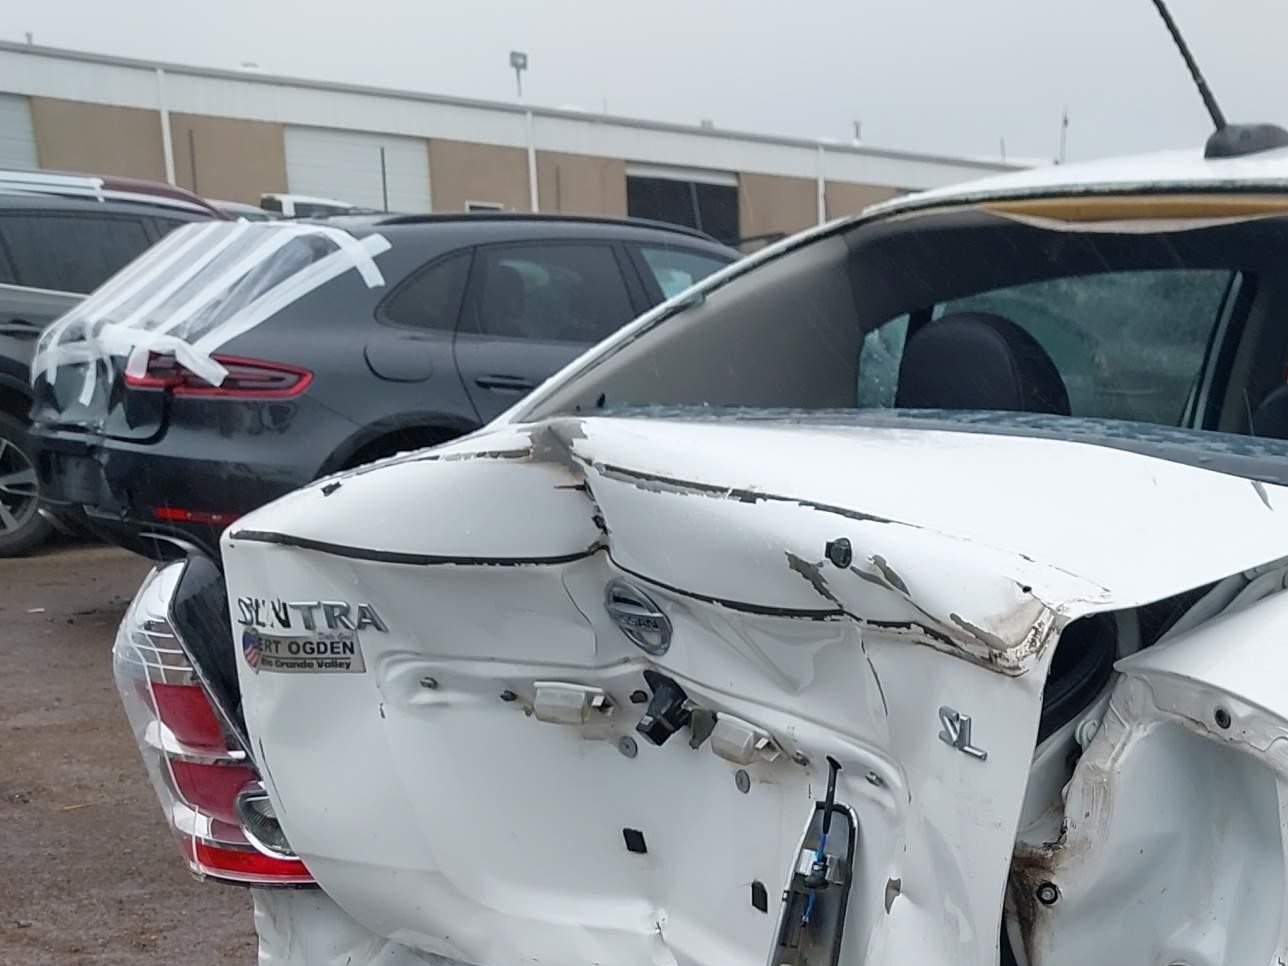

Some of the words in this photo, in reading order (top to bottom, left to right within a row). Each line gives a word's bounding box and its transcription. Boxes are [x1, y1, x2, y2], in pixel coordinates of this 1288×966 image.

[257, 637, 281, 653] ERT
[287, 640, 355, 655] OGDEN
[274, 659, 314, 669] Grande
[316, 660, 352, 670] Valley
[938, 705, 988, 762] SL
